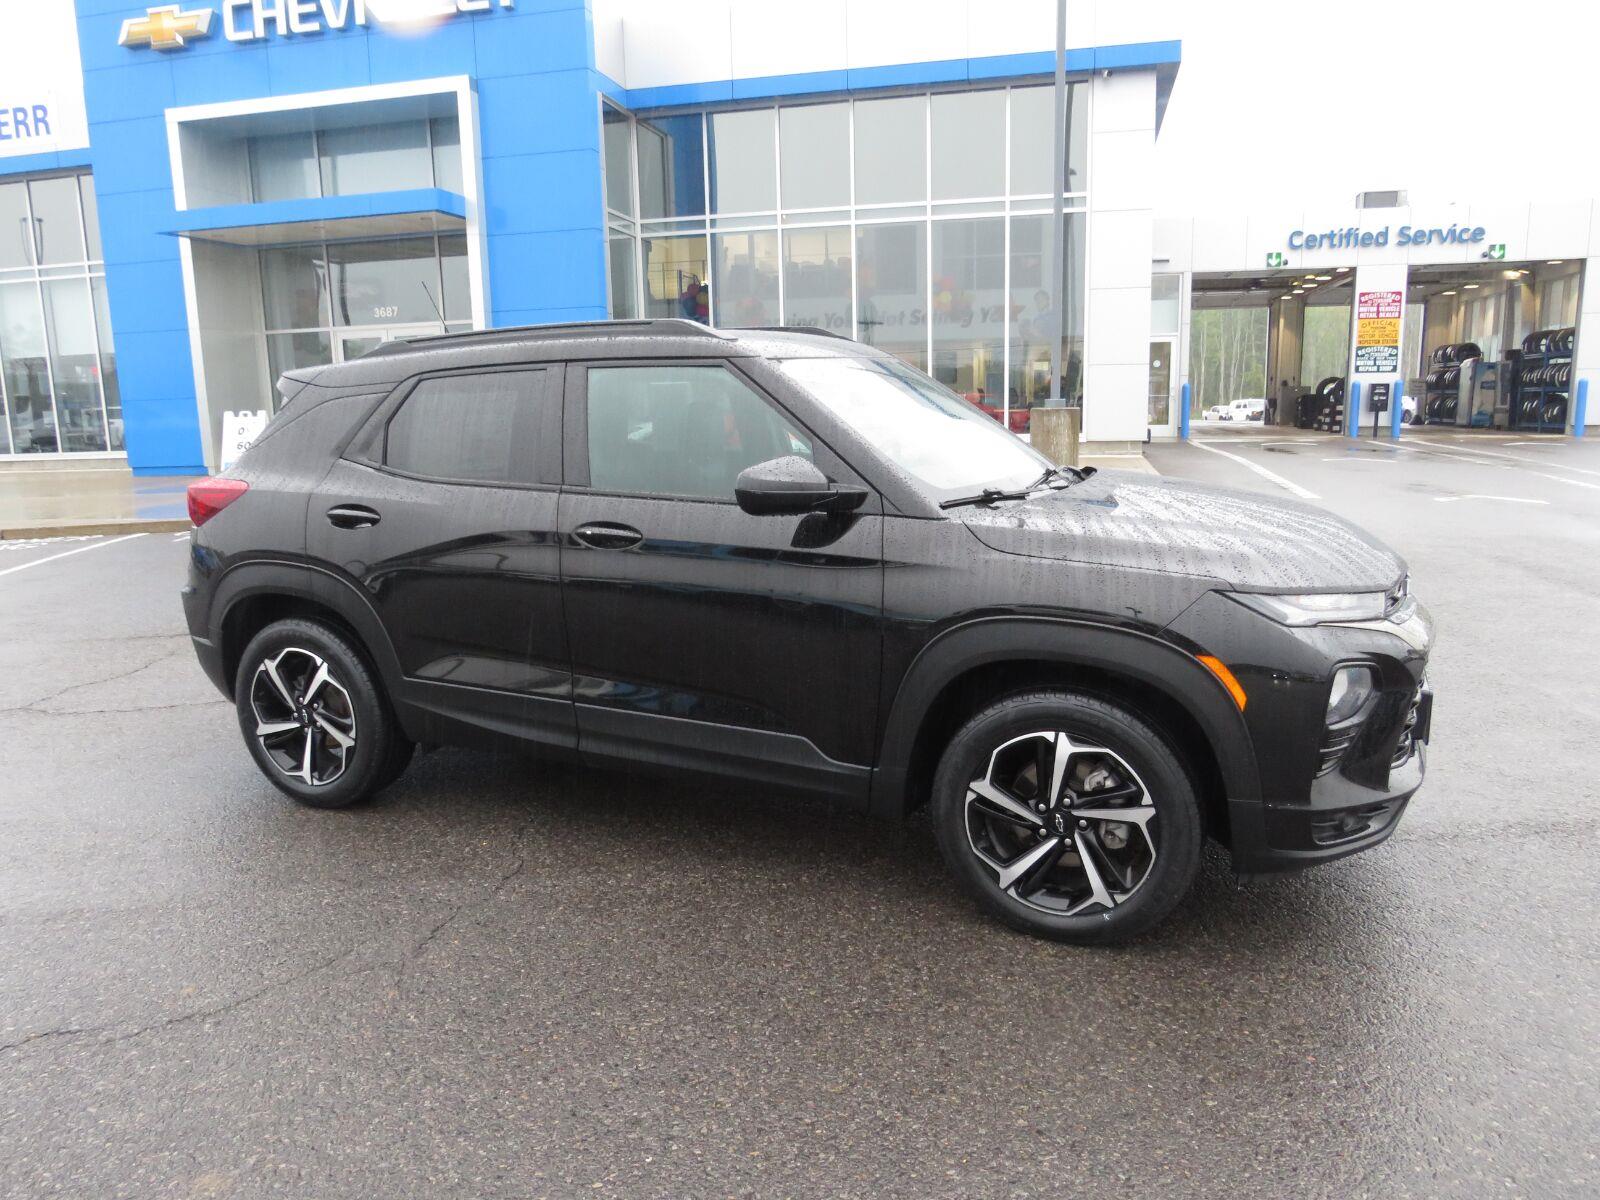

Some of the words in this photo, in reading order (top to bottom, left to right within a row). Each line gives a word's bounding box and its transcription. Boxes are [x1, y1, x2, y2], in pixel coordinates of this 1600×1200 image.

[1288, 226, 1389, 250] Certified
[1396, 223, 1486, 246] Service
[1360, 292, 1401, 302] REGISTERED
[374, 306, 398, 318] 3687
[1361, 320, 1397, 329] OFFICIAL
[1357, 346, 1397, 356] REGISTERED
